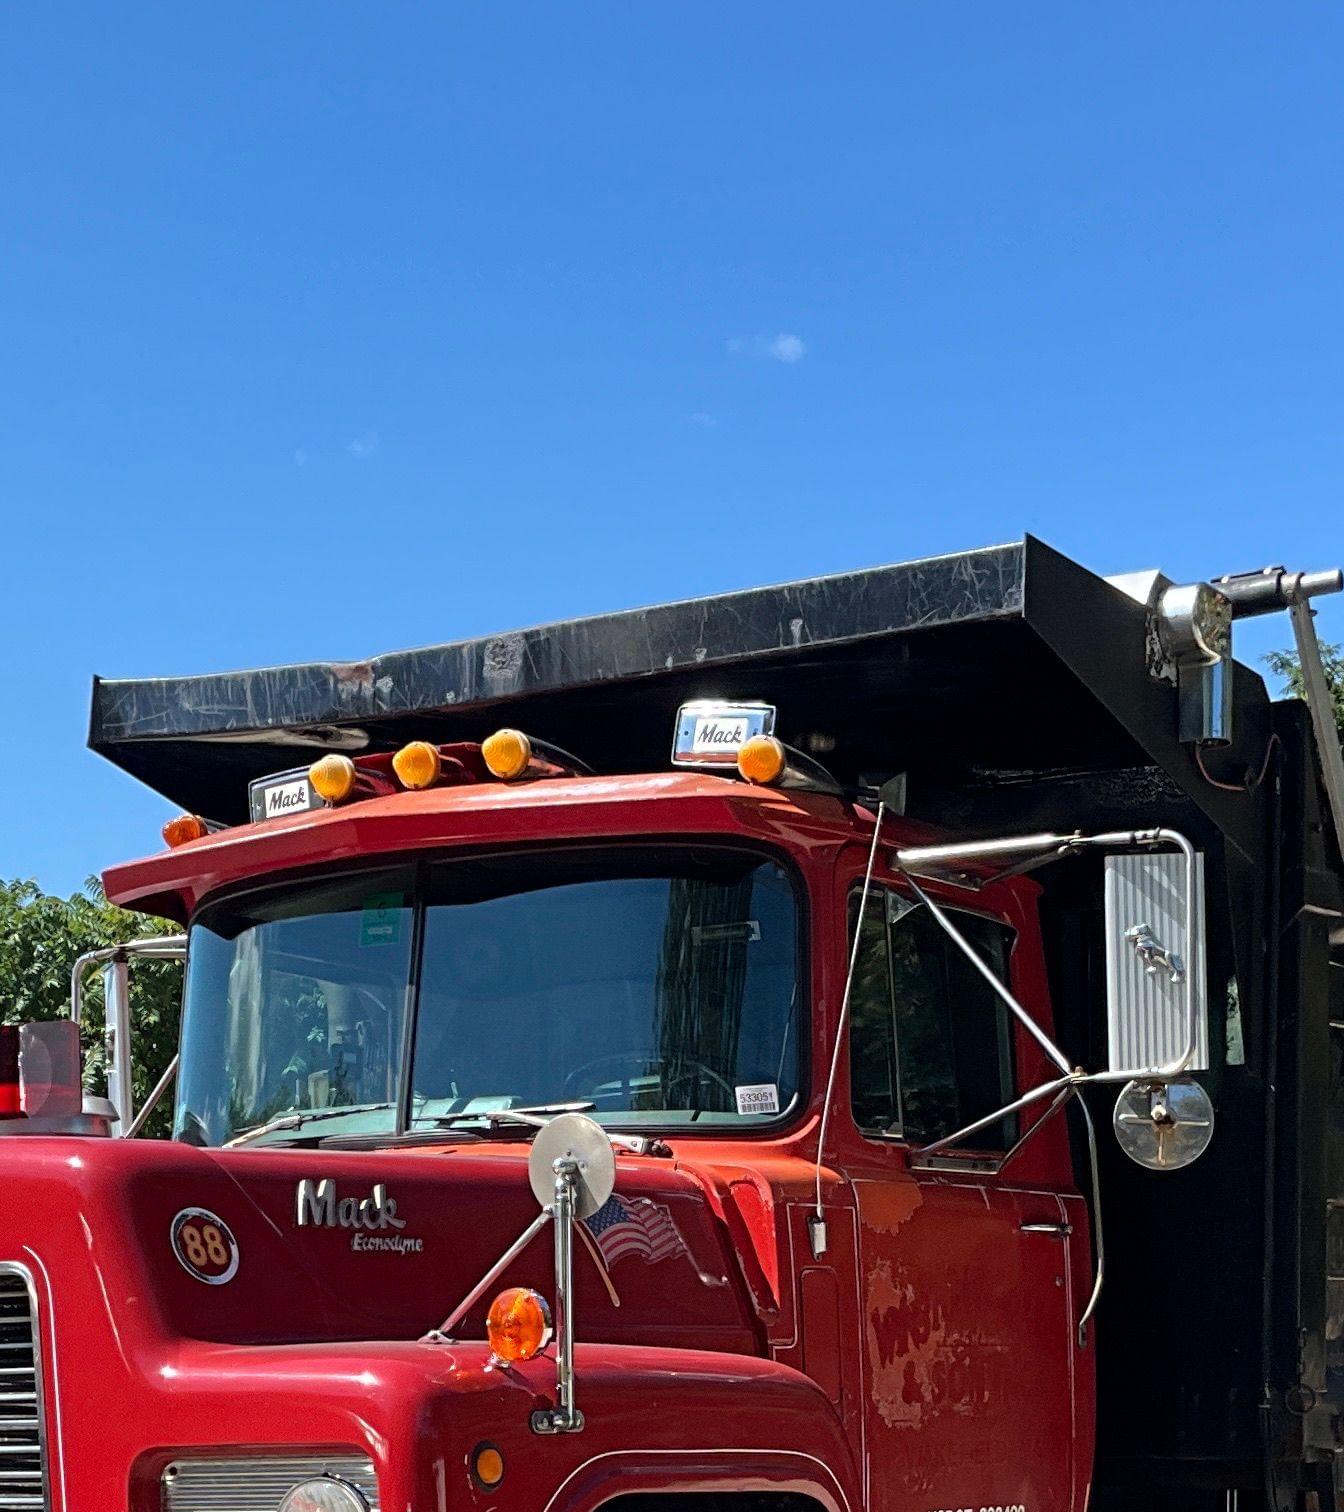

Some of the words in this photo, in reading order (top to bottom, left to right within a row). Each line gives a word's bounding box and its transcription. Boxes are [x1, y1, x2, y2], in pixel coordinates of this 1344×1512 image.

[698, 723, 742, 743] Mack
[269, 786, 306, 811] Mack
[739, 1091, 773, 1104] 533051
[295, 1179, 406, 1229] Mack
[182, 1224, 228, 1266] 88
[351, 1232, 424, 1255] Econodyne
